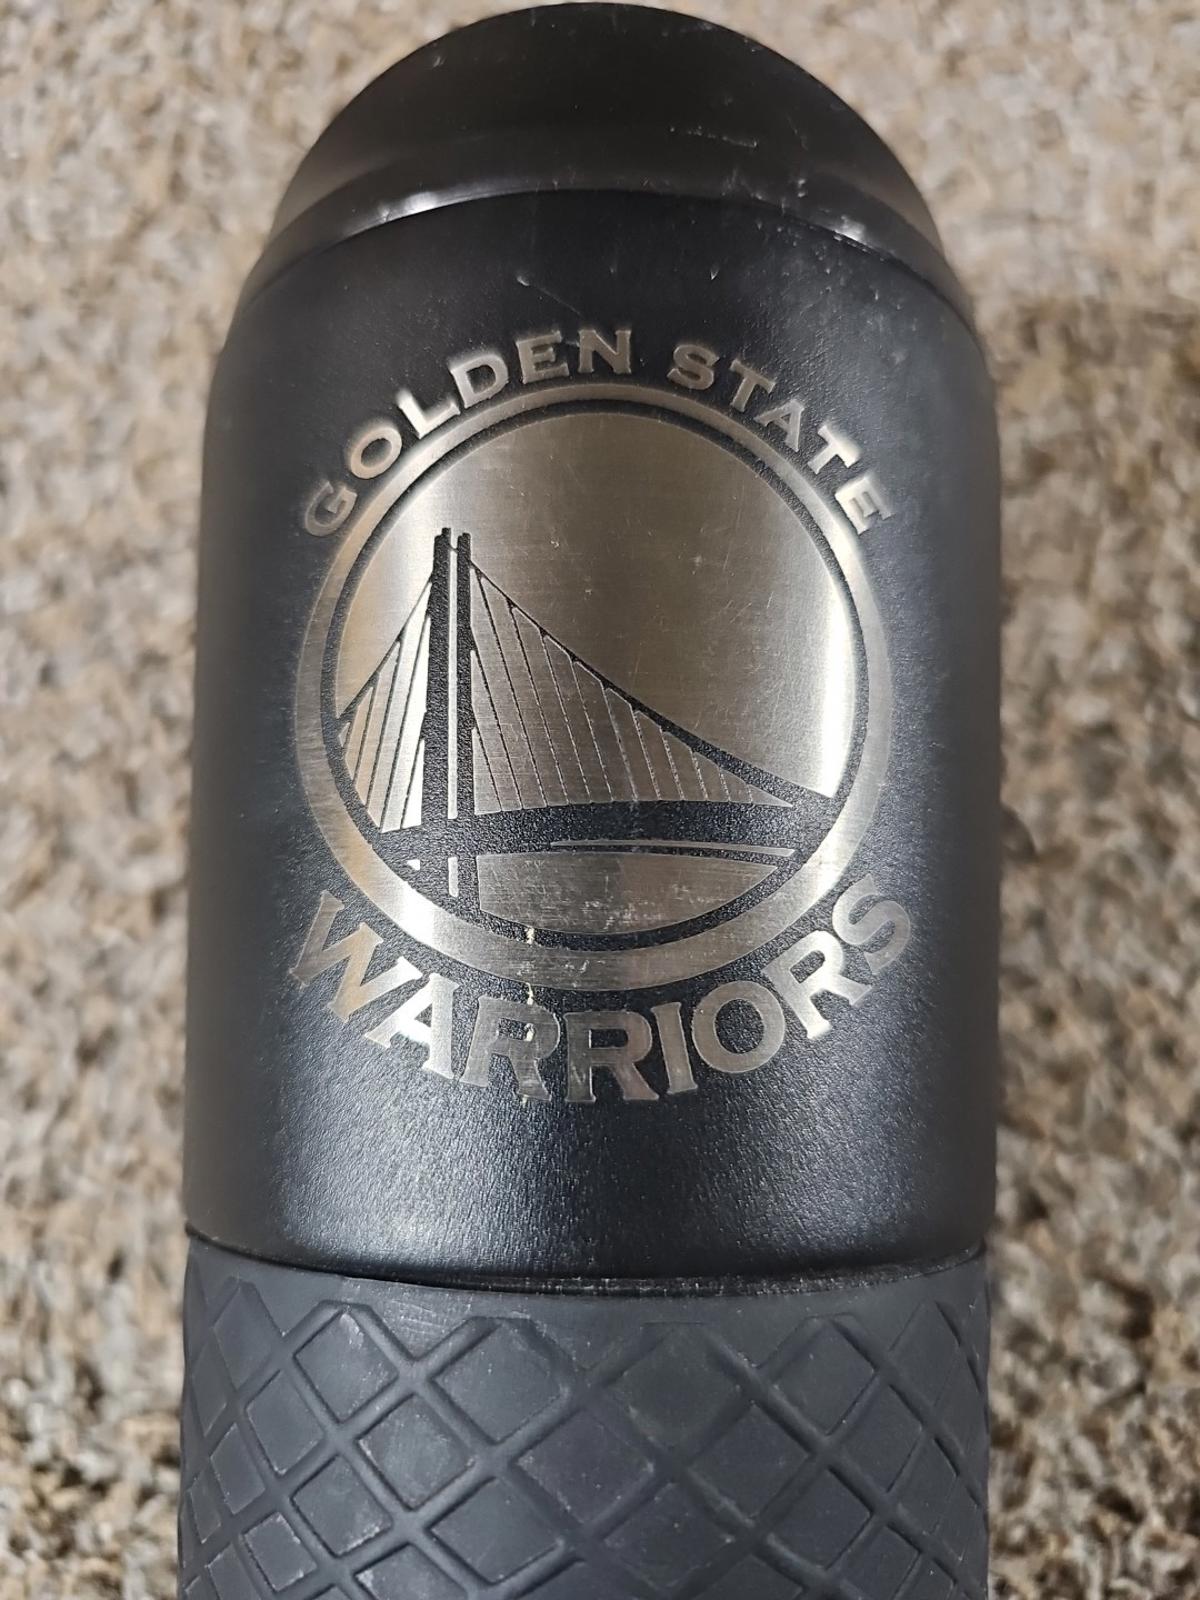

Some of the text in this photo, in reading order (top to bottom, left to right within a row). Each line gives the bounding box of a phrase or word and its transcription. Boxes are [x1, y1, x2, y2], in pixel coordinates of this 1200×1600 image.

[302, 328, 896, 537] GOLDEN STATE
[288, 873, 911, 1103] WARRIORS
